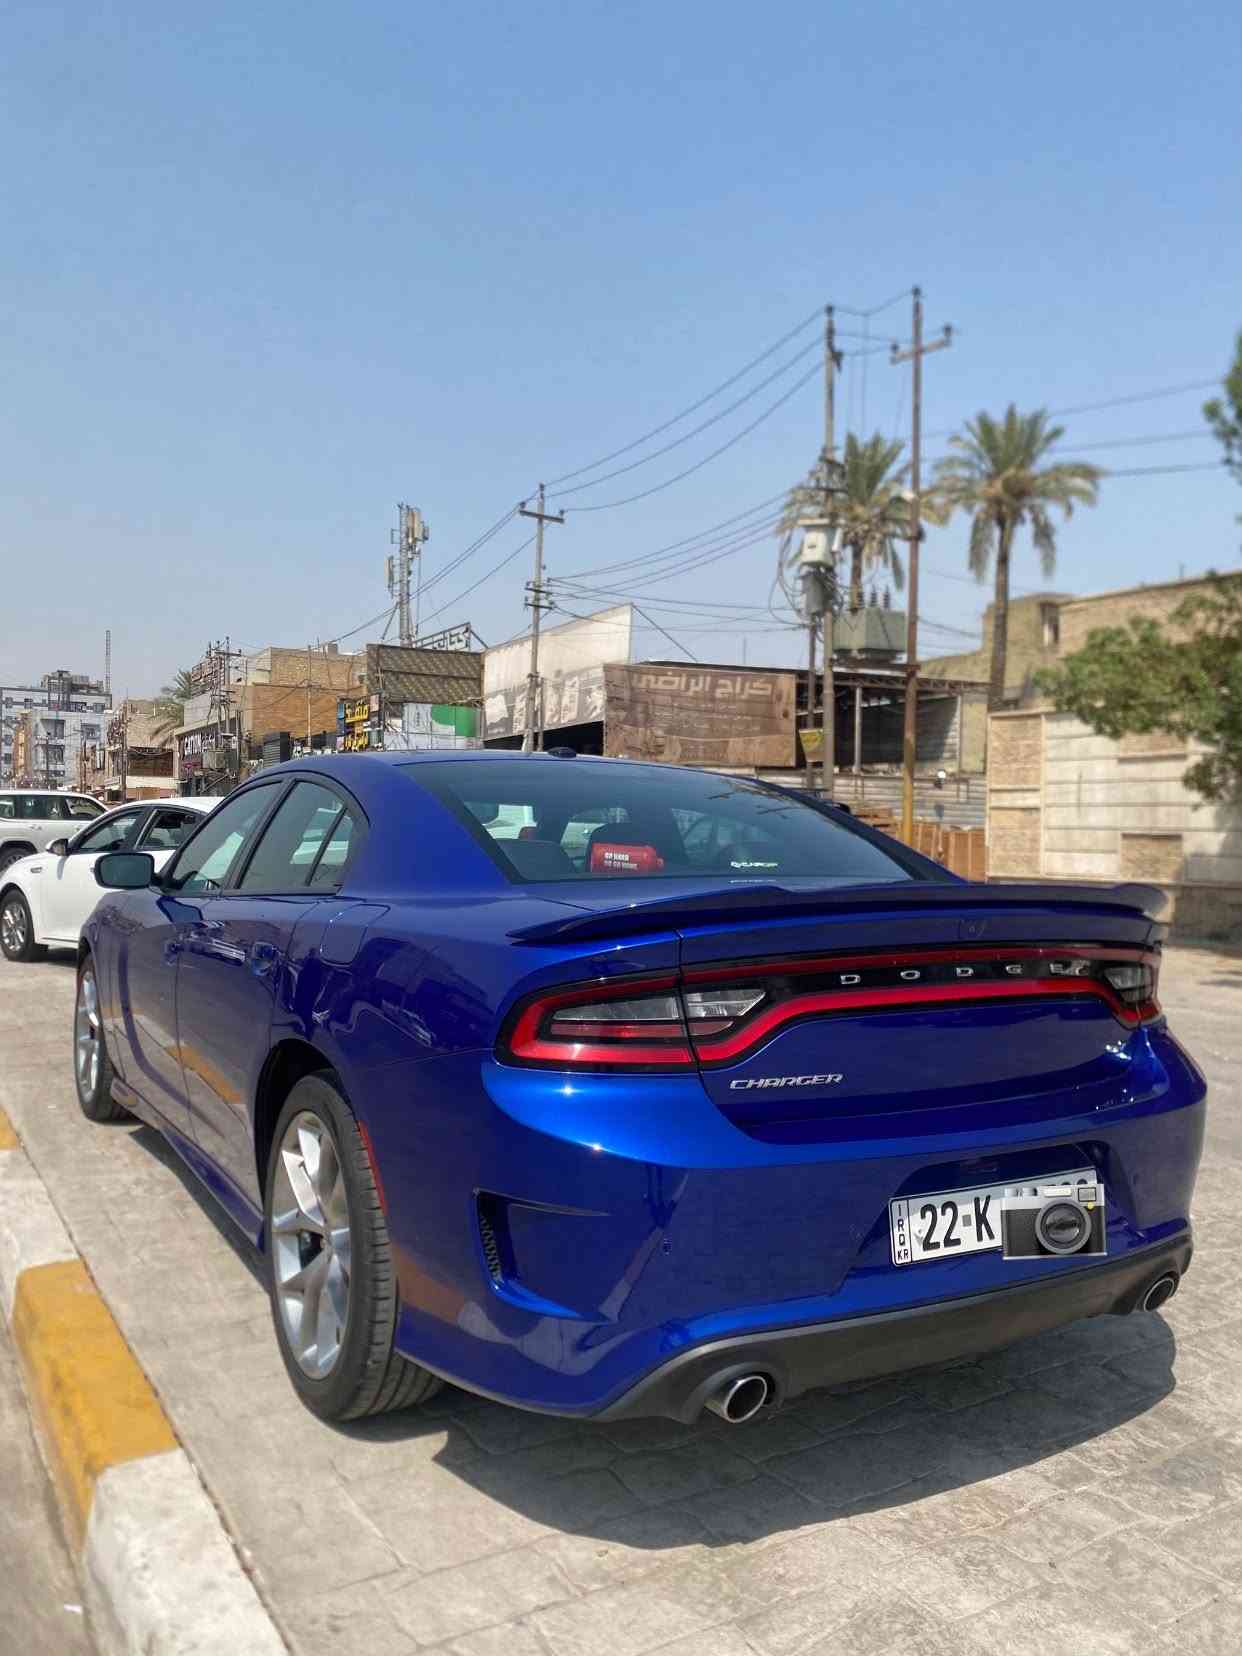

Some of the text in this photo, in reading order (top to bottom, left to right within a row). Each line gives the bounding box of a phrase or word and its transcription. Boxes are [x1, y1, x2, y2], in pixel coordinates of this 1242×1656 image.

[839, 963, 1065, 985] DODGE
[729, 1073, 844, 1090] CHARGER
[920, 1194, 996, 1252] 22 K
